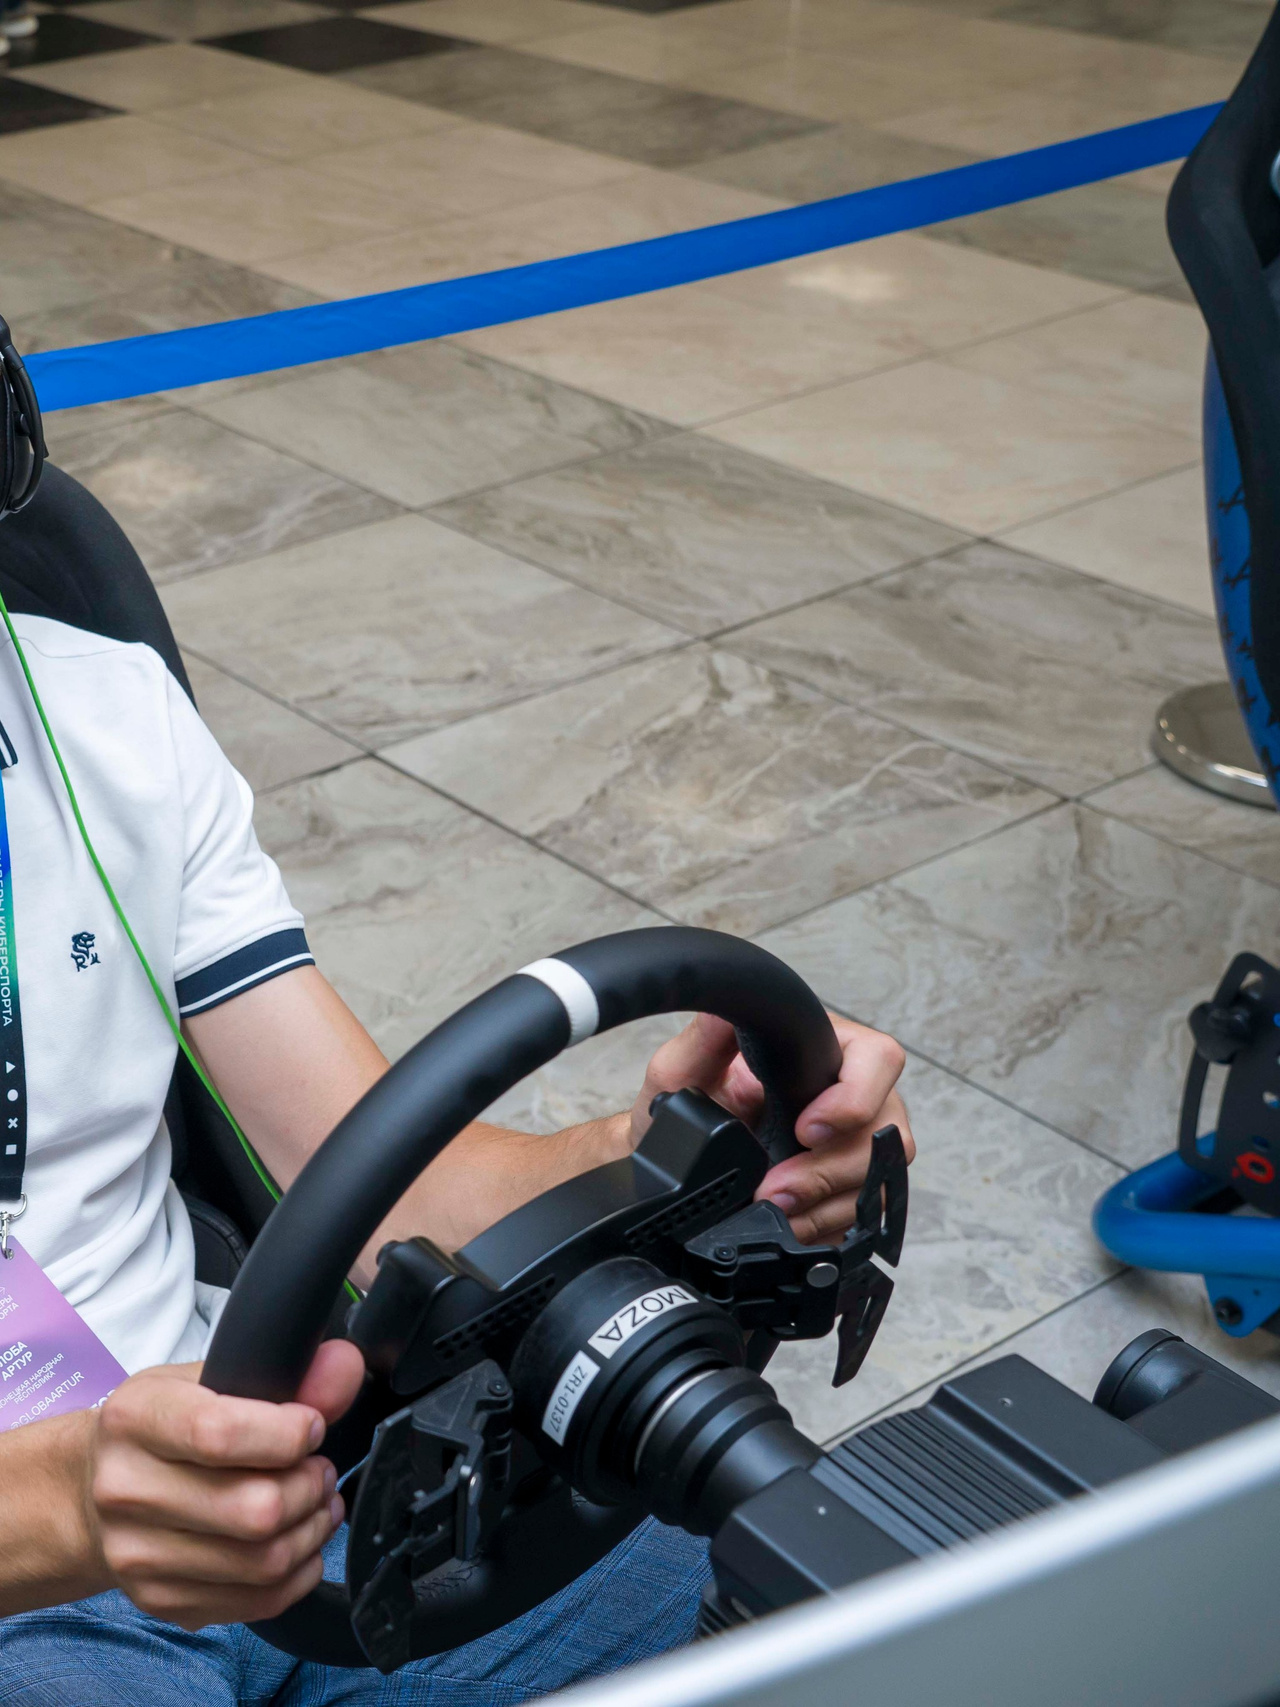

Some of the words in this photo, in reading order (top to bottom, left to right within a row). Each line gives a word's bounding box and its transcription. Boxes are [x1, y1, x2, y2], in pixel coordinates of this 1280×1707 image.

[597, 1287, 690, 1342] MOZA
[1, 1351, 33, 1382] АРТУР
[28, 1352, 64, 1383] НАРОДНАЯ
[13, 1370, 56, 1404] РЕСПУБЛИКА
[550, 1364, 589, 1434] ZR1-0137
